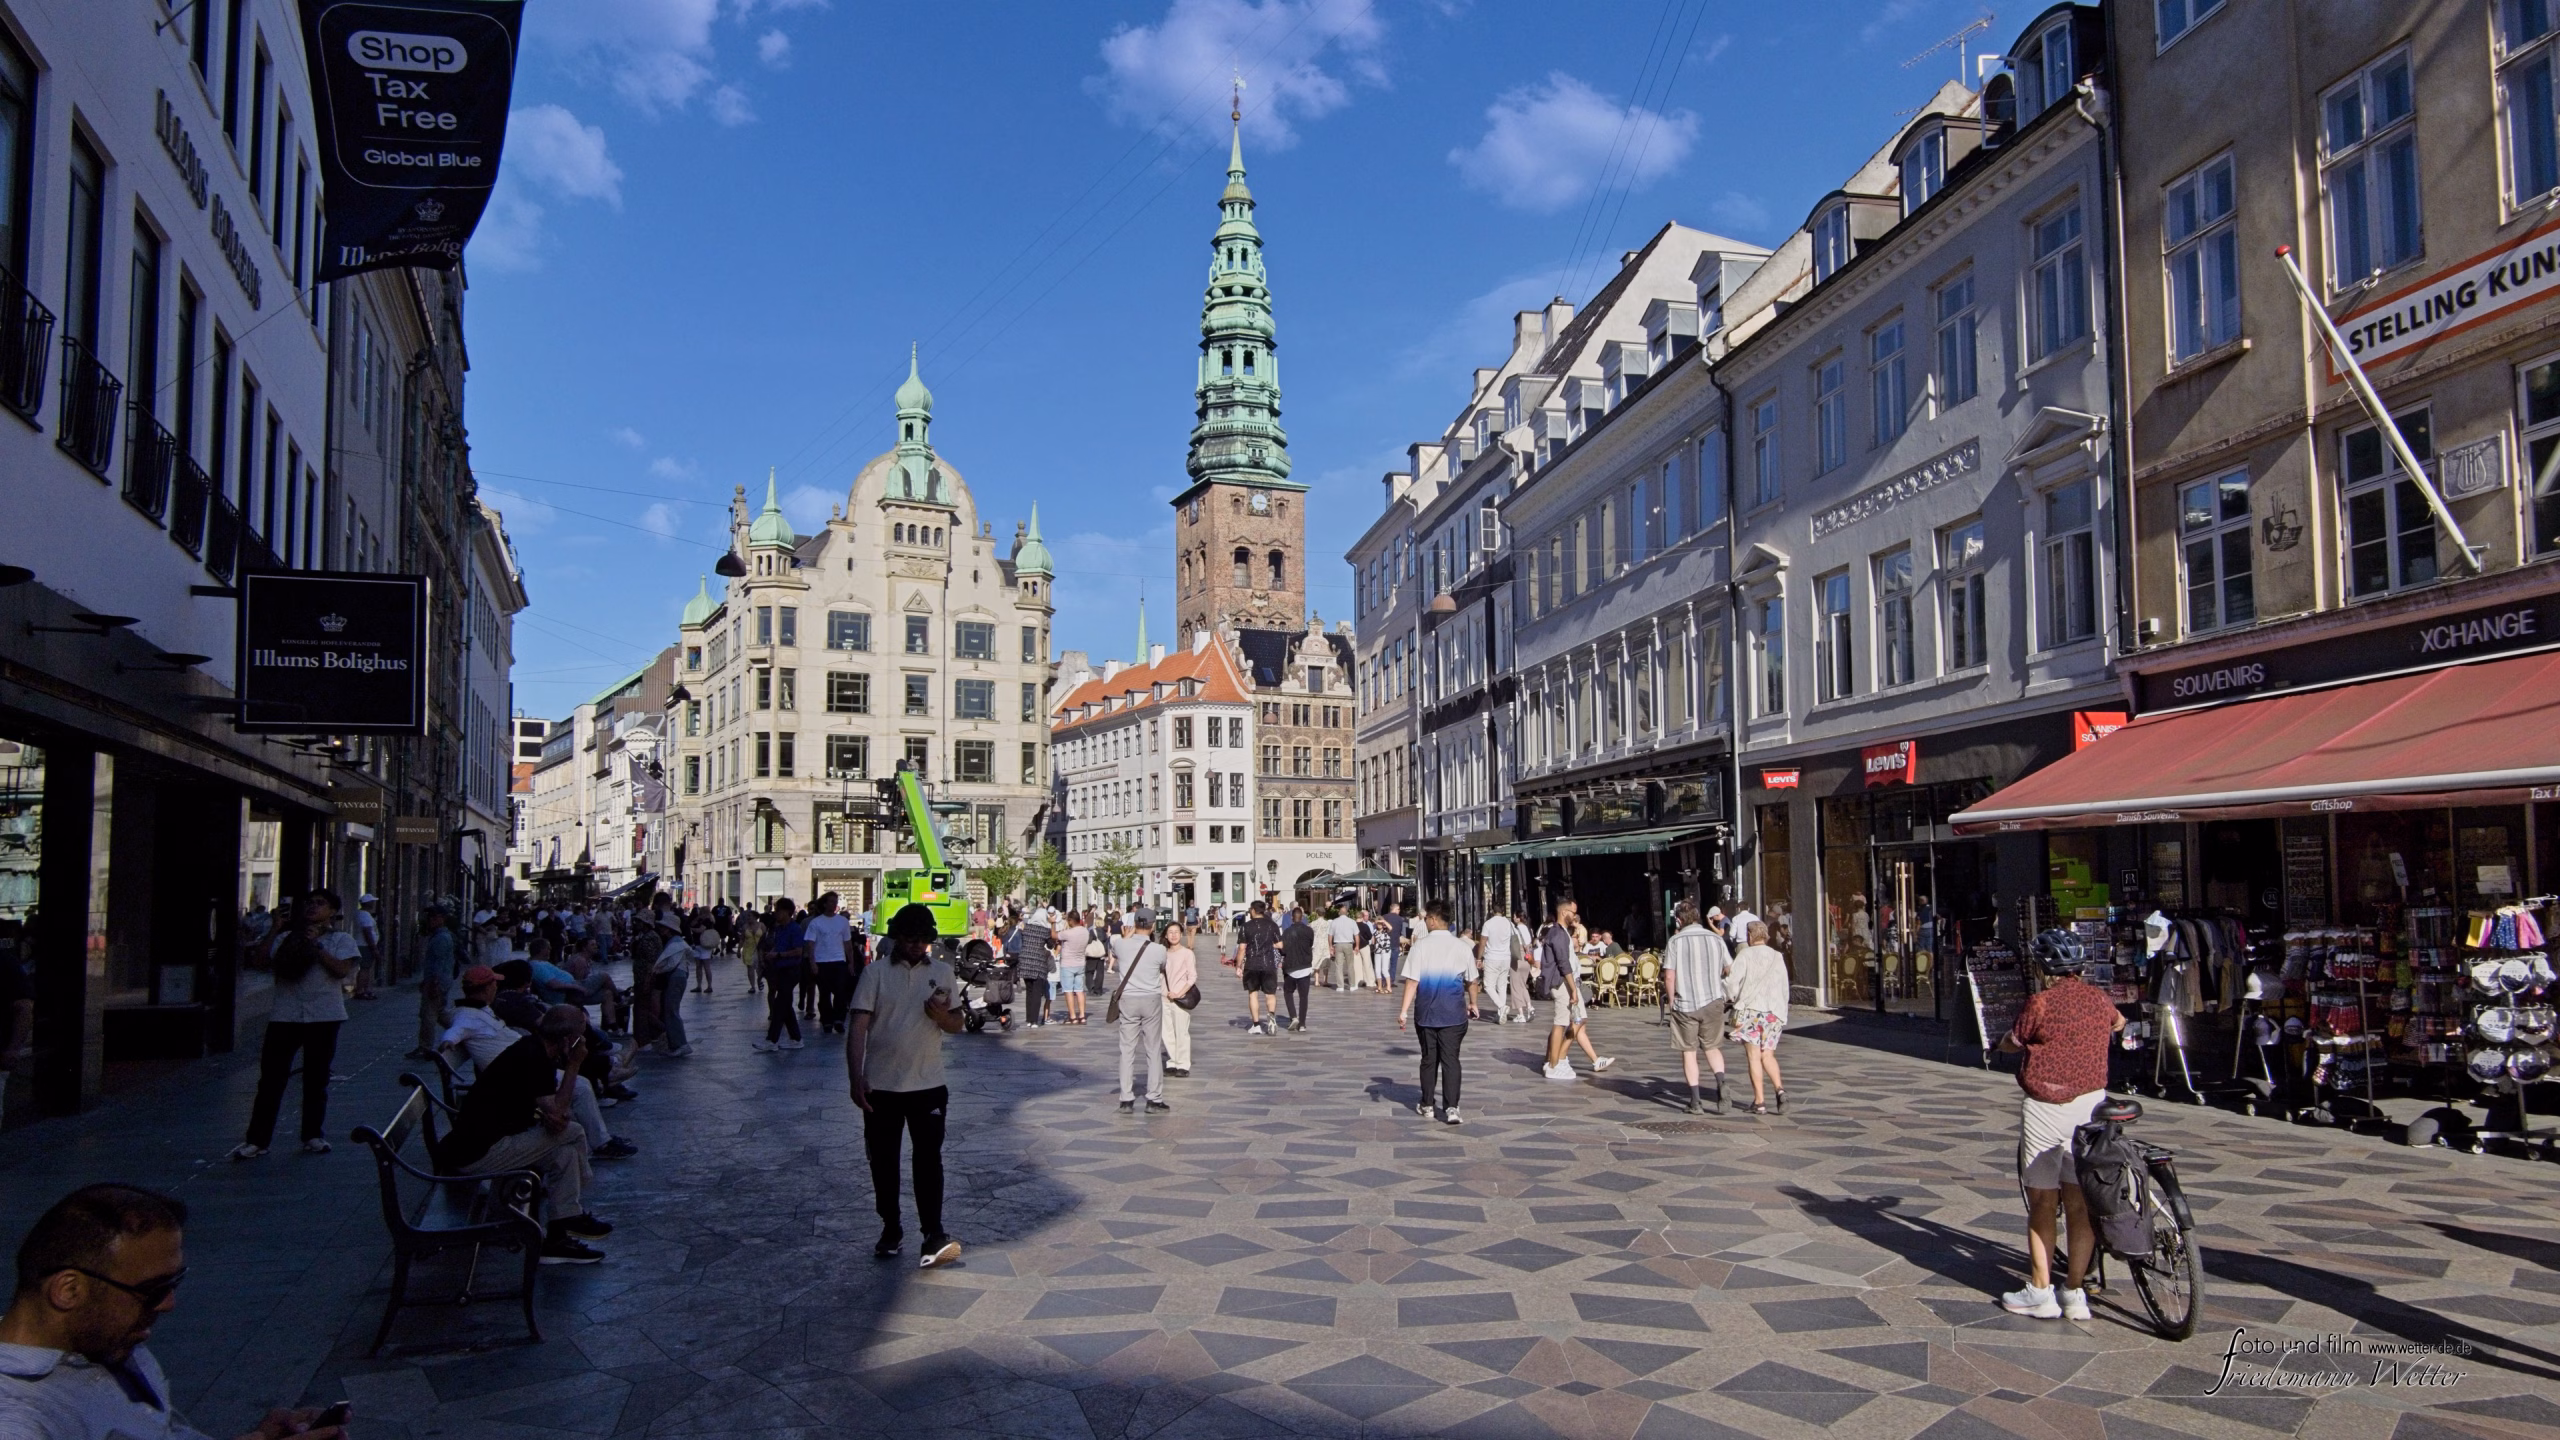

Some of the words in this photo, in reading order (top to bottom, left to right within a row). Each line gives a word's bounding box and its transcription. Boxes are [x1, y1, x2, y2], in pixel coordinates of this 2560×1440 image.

[360, 36, 454, 70] Shop
[364, 73, 430, 100] Tax
[377, 103, 457, 130] Free
[364, 149, 434, 167] Global
[439, 152, 482, 167] Blue
[2349, 280, 2477, 355] STELLING
[2489, 243, 2560, 297] KUN
[2420, 609, 2536, 653] XCHANGE
[254, 649, 319, 668] Illums
[323, 651, 408, 673] Bolighus
[2173, 663, 2265, 697] SOUVENIRS
[2310, 799, 2352, 811] Giftshop
[2530, 788, 2551, 799] Tax
[2117, 812, 2142, 823] Danish
[2143, 810, 2180, 822] Souvenirs
